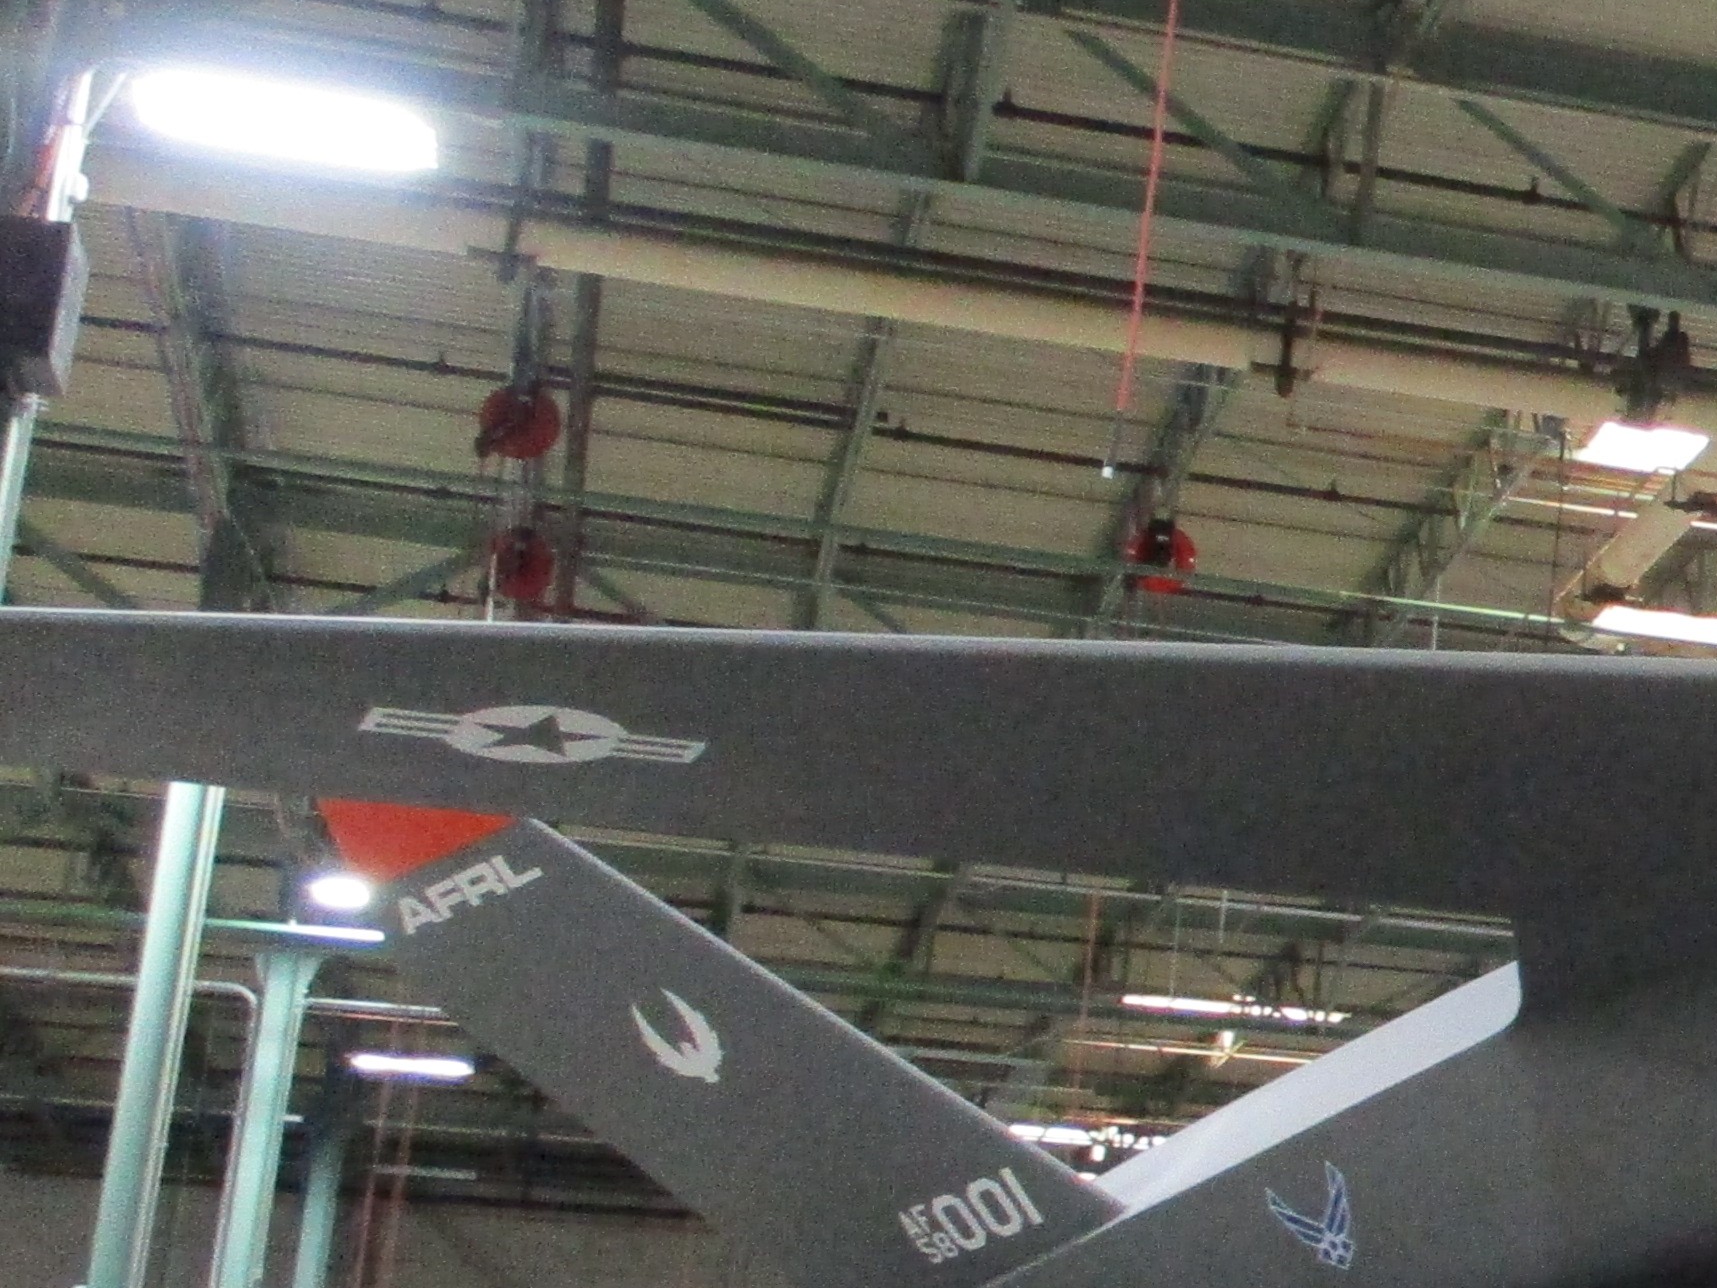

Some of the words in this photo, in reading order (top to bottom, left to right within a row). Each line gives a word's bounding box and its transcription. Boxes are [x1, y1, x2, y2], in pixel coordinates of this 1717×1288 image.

[399, 854, 544, 936] AFRL
[899, 1203, 931, 1239] AF
[931, 1166, 1044, 1252] 001
[915, 1232, 959, 1264] 58
